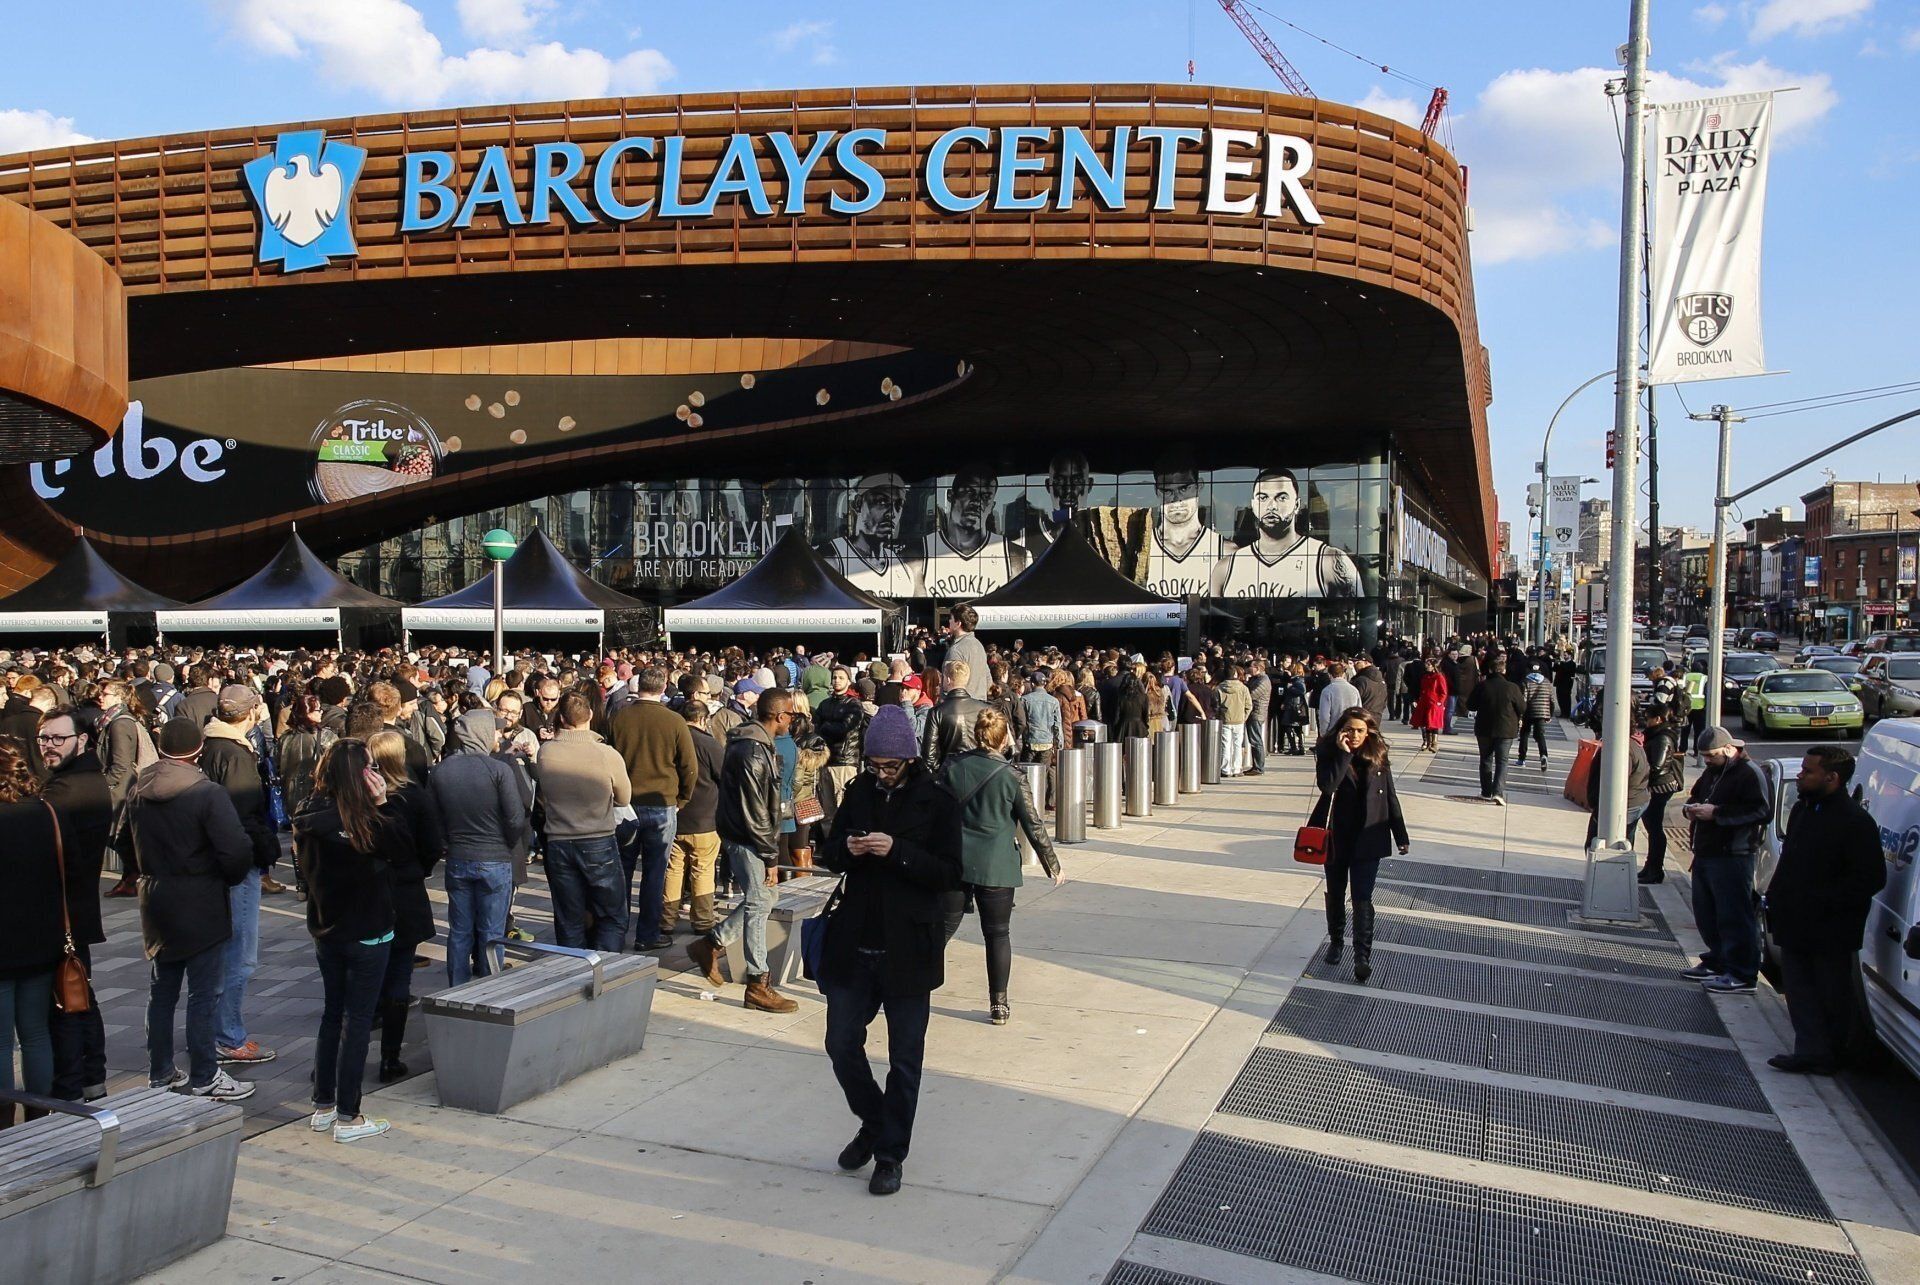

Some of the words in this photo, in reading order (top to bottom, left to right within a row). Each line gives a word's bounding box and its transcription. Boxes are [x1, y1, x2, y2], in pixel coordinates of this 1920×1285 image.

[1664, 126, 1759, 155] DAILY
[1664, 148, 1757, 177] NEWS
[400, 128, 887, 231] BARCLAYS
[926, 126, 1325, 224] CENTER
[1678, 176, 1741, 196] PLAZA
[1678, 295, 1730, 319] NETS
[1698, 320, 1708, 339] B
[1677, 349, 1732, 367] BROOKLYN
[343, 419, 404, 444] Tribe
[333, 445, 370, 456] CLASSIC
[635, 521, 777, 556] BROOKLYN
[635, 560, 661, 578] ARE
[666, 560, 693, 578] YOU
[928, 574, 1001, 598] BROOKLY
[1148, 577, 1210, 598] ROOKLY
[267, 616, 292, 624] PHONE
[293, 616, 318, 624] CHECK
[424, 615, 439, 624] THE
[458, 616, 473, 624] FAN
[525, 617, 552, 625] PHONE
[553, 617, 580, 625] CHECK
[688, 616, 704, 625] THE
[706, 617, 724, 625] EPIC
[725, 617, 741, 625] FAN
[743, 617, 790, 625] EXPERIENCE
[798, 617, 826, 625] PHONE
[828, 617, 857, 625] CHECK
[862, 617, 877, 625] HBO
[1020, 613, 1037, 621] FAN
[1039, 613, 1089, 621] EXPERIENCE
[1098, 612, 1128, 620] PHONE
[1130, 611, 1161, 620] CHECK
[1879, 825, 1901, 853] EWS
